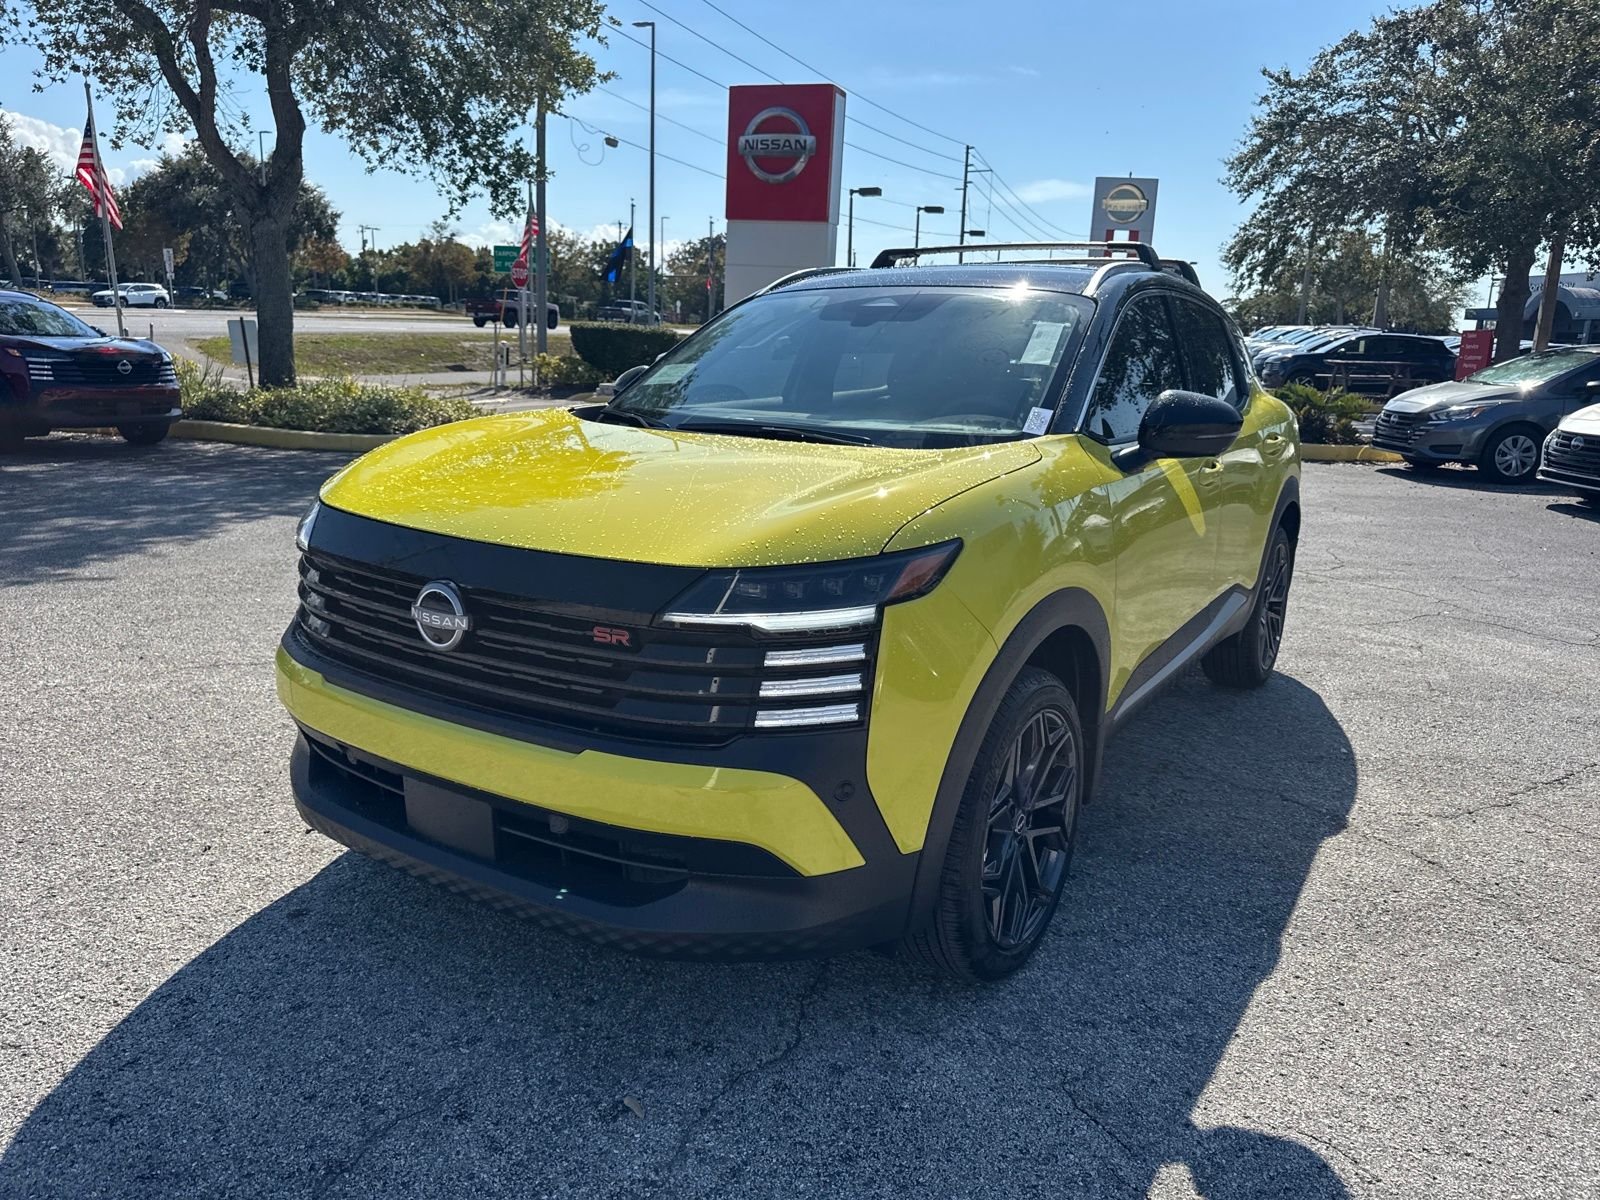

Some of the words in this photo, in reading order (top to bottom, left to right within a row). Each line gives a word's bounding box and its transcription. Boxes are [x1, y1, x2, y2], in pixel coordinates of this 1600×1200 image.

[744, 139, 807, 151] NISSAN
[512, 267, 528, 279] STOP
[411, 606, 467, 628] NISSAN
[593, 626, 630, 647] SR
